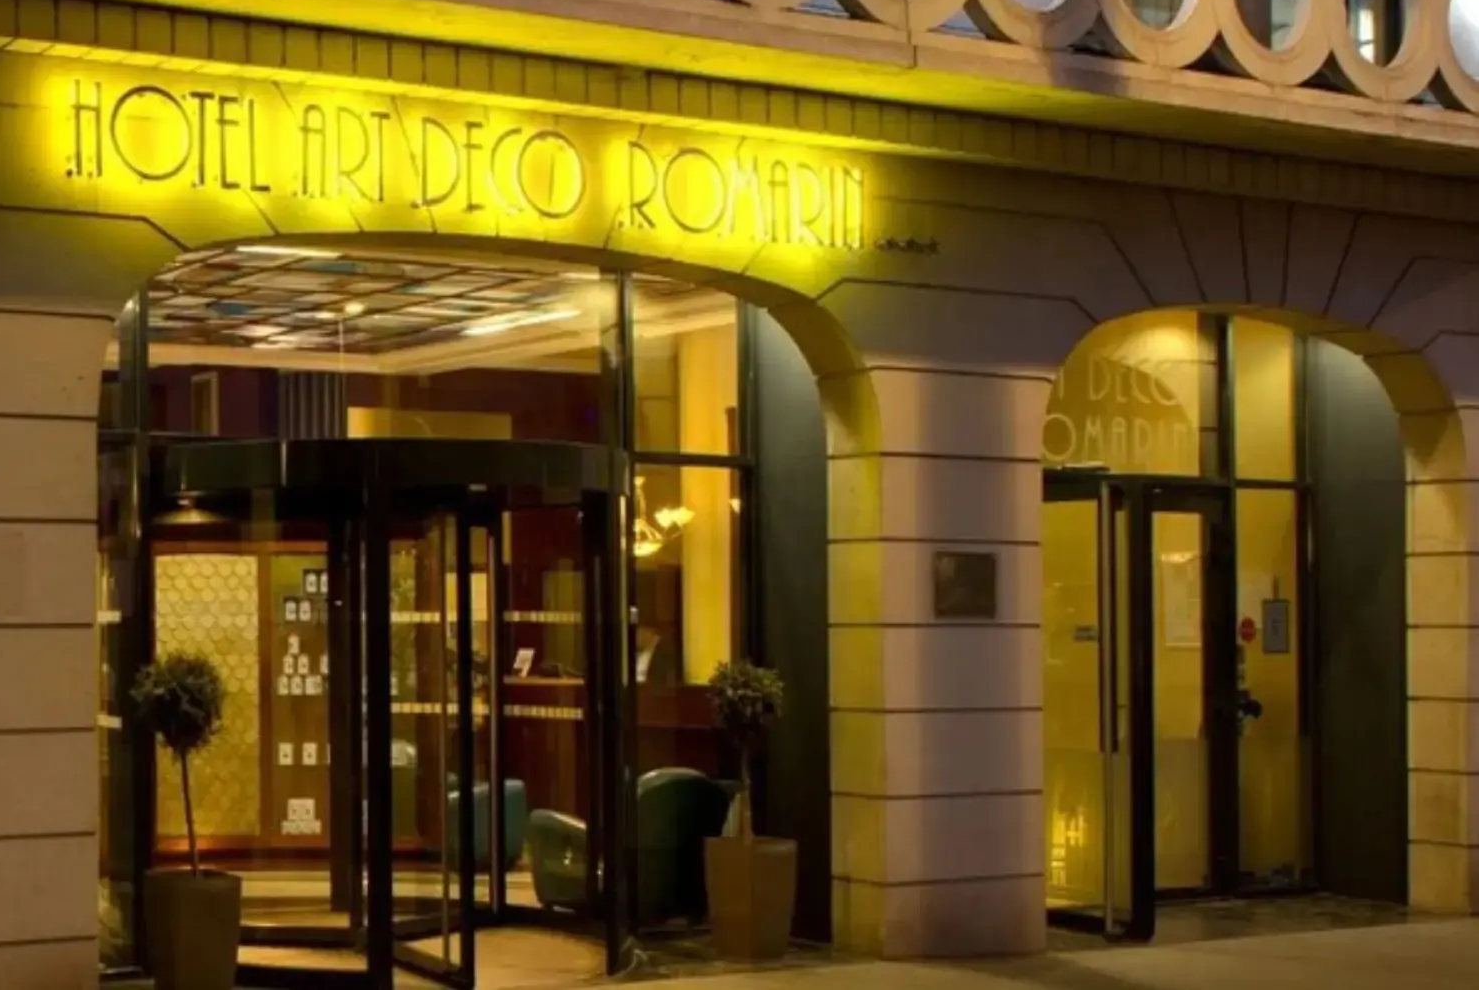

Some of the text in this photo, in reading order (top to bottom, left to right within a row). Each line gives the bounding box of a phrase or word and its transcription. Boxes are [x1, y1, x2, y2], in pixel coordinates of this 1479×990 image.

[70, 78, 865, 249] HOTEL ART DECO ROMARIN
